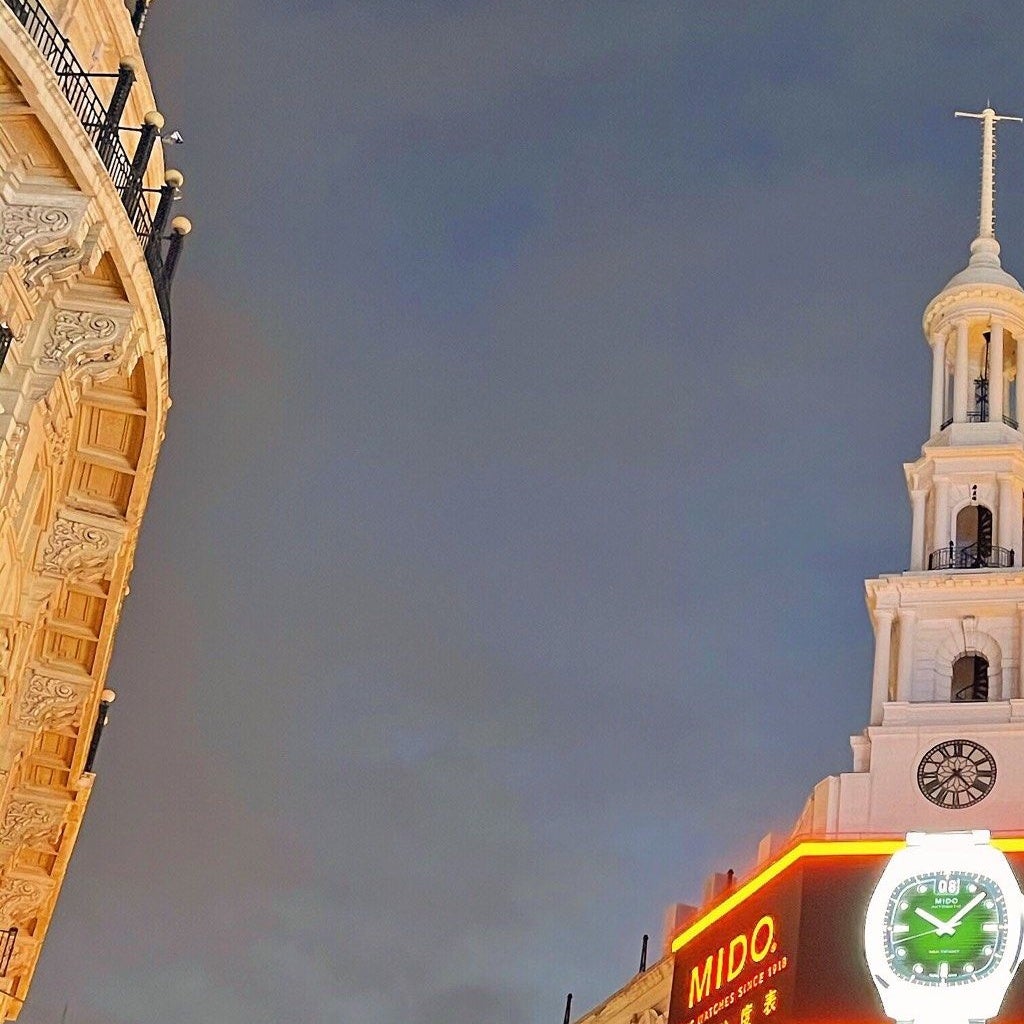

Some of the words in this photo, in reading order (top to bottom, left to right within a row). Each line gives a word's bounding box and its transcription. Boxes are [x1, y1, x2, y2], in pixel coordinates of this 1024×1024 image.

[934, 897, 959, 905] MIDO
[688, 915, 774, 1009] MIDO
[738, 971, 764, 998] SINCE
[768, 956, 788, 978] 1918
